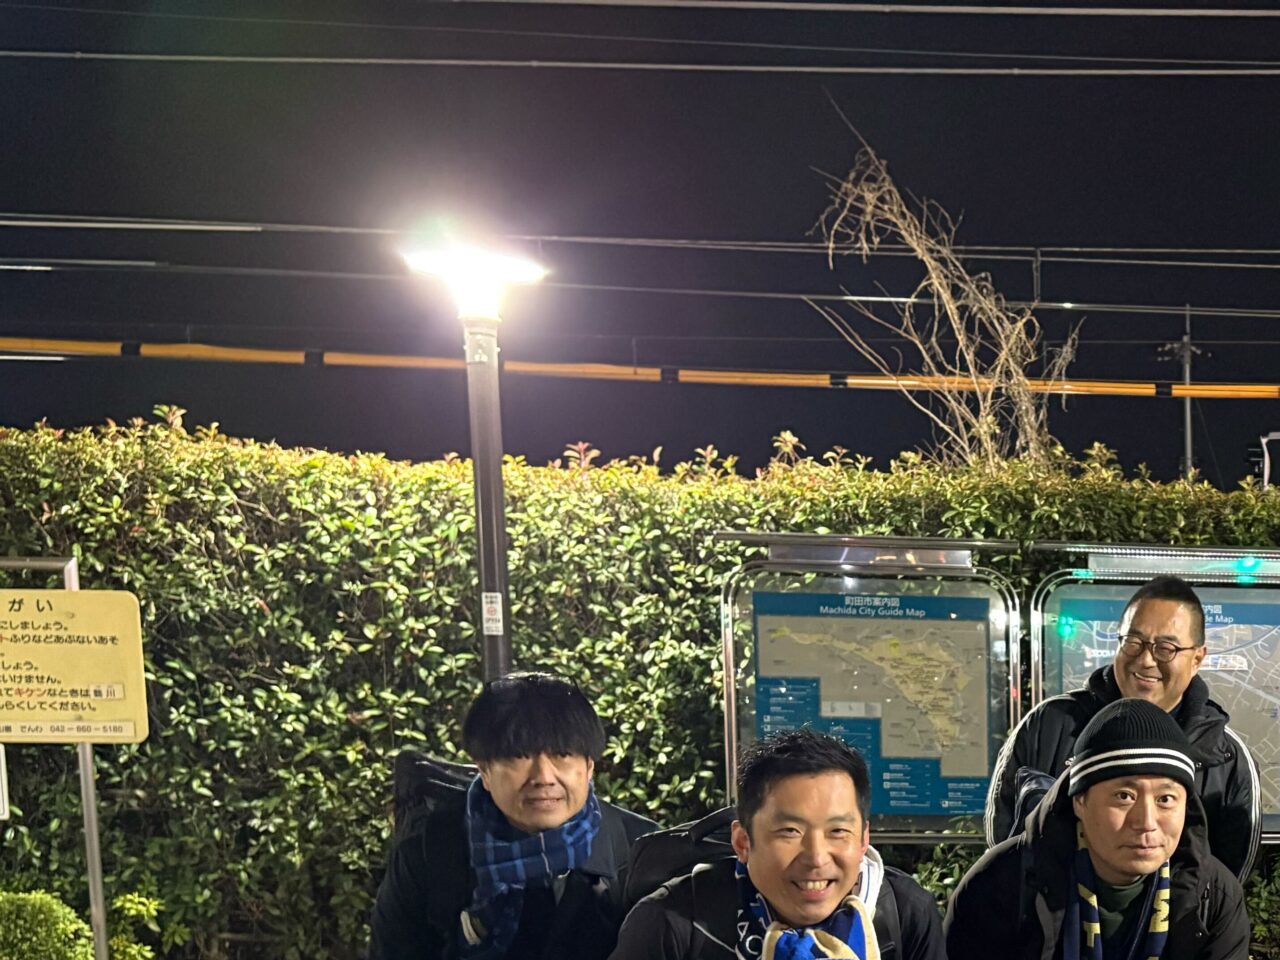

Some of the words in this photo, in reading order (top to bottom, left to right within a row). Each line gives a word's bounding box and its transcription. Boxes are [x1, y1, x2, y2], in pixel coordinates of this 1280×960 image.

[819, 605, 857, 616] Machida
[858, 606, 876, 618] City
[878, 607, 904, 617] Guide
[905, 608, 926, 619] Map
[1215, 615, 1234, 624] Map
